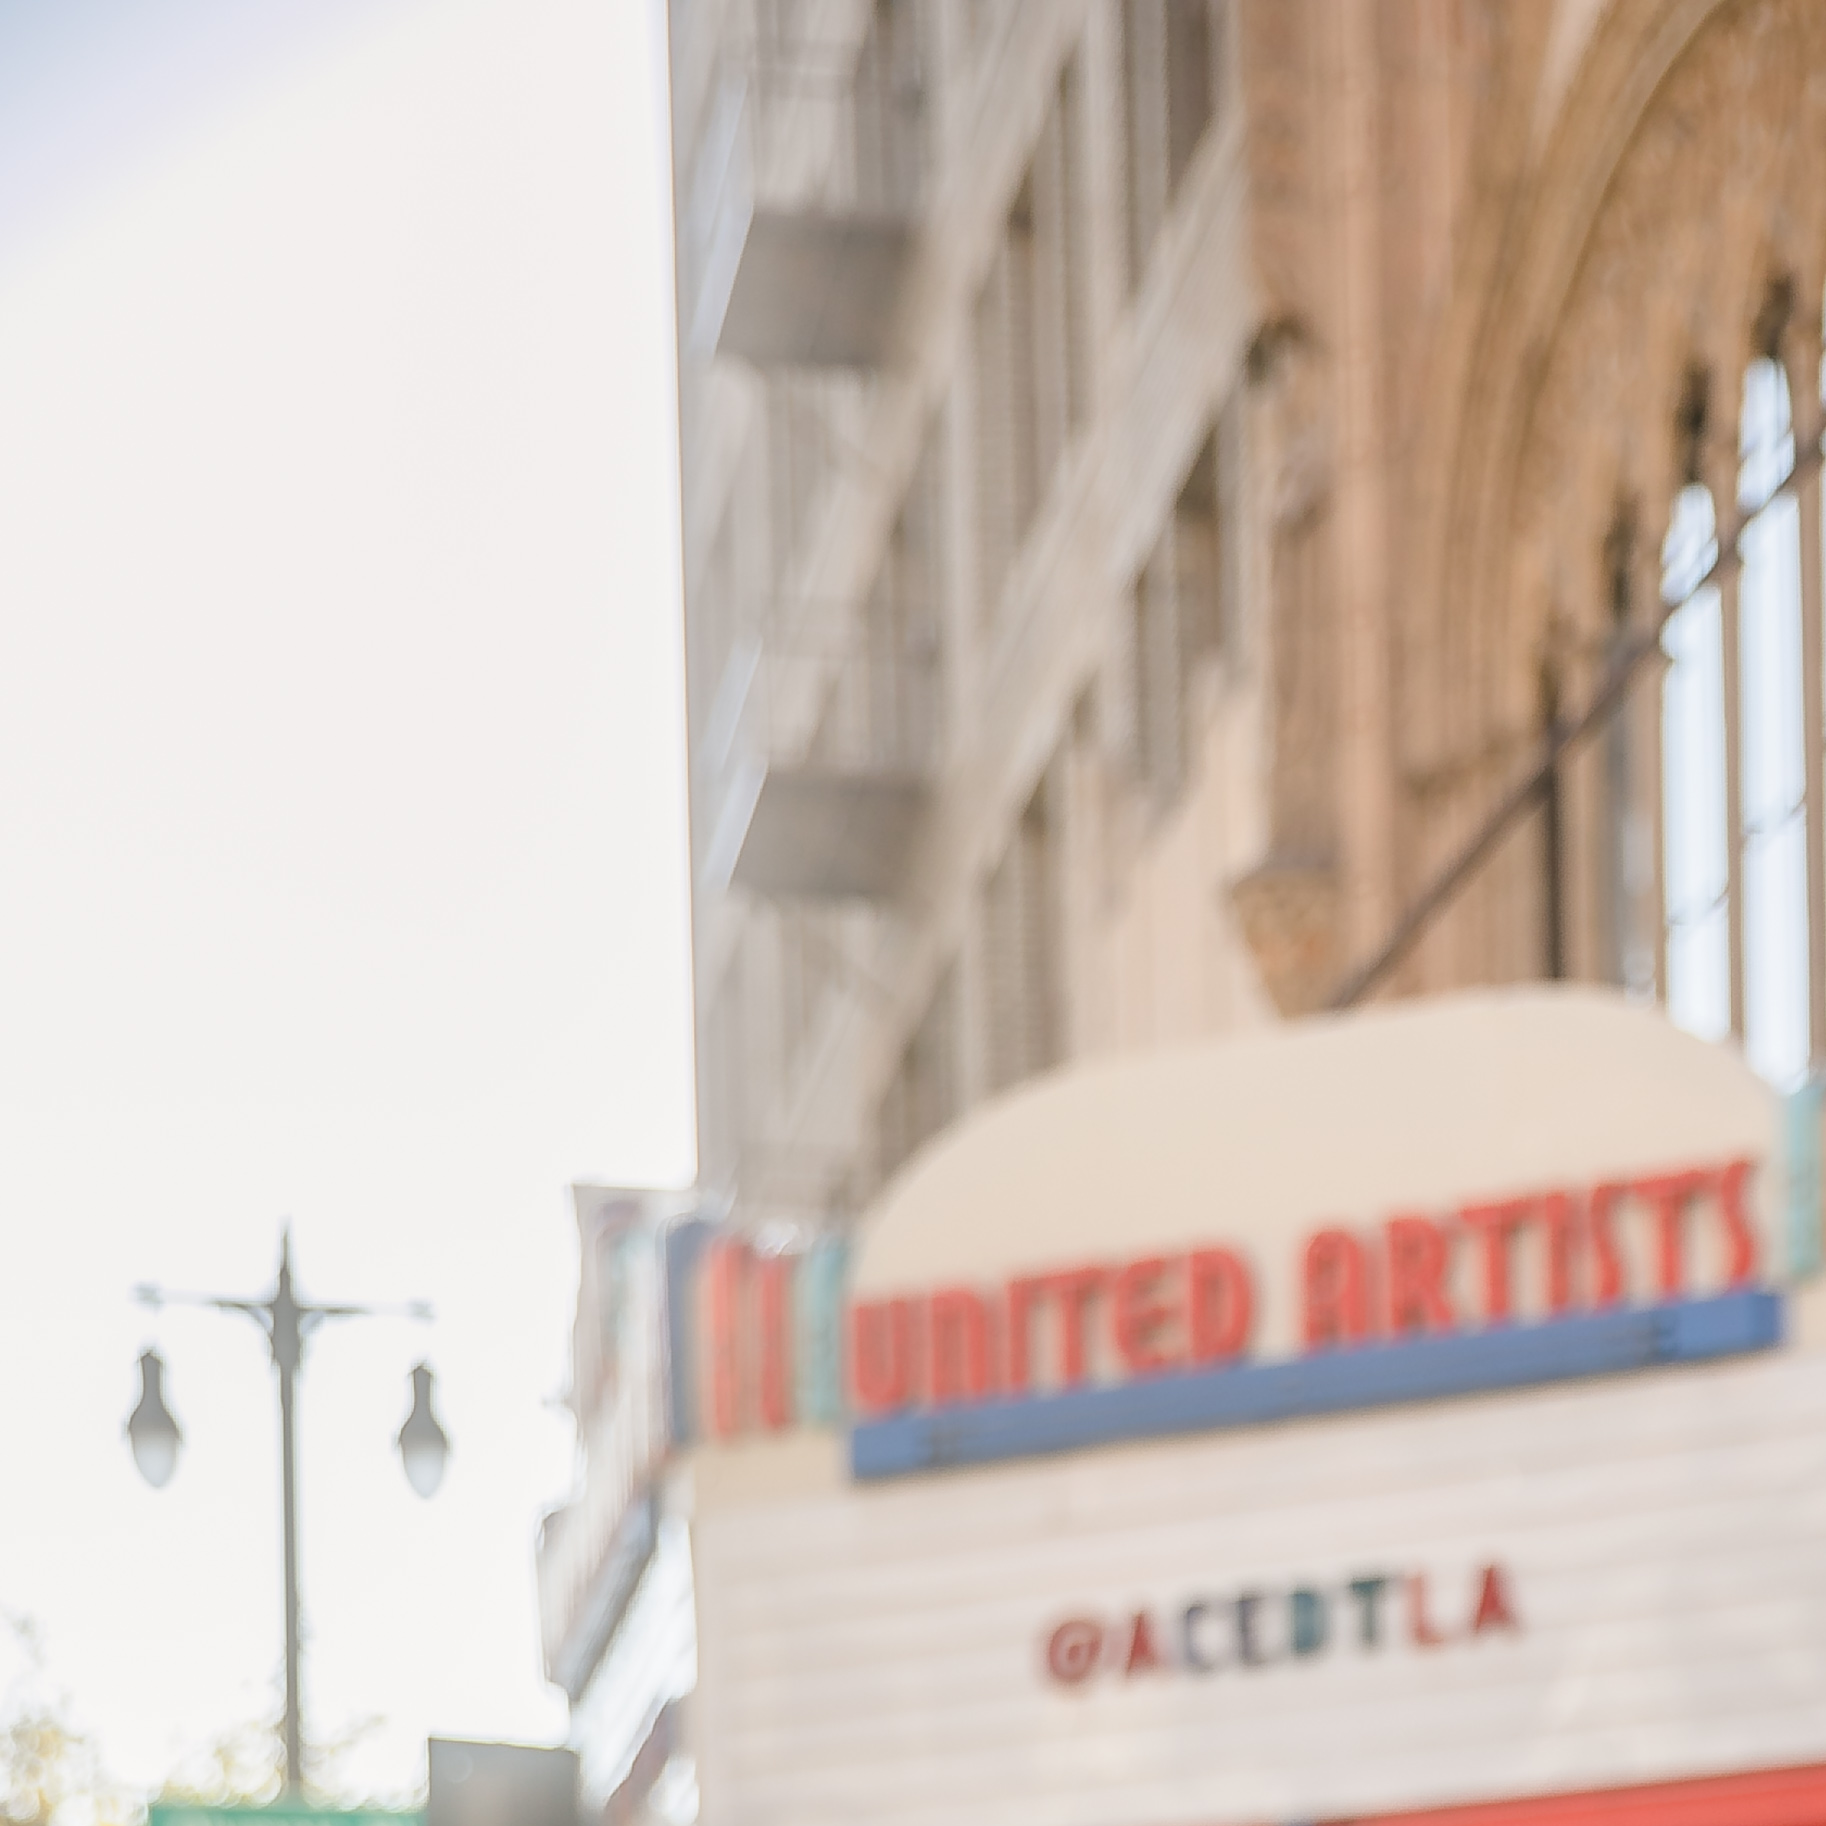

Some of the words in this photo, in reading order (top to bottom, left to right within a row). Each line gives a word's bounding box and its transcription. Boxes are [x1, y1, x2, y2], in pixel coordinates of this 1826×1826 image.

[853, 1245, 1252, 1412] UNITED
[1301, 1159, 1757, 1349] ARTISTS
[1042, 1563, 1517, 1686] @ACEDTLA
